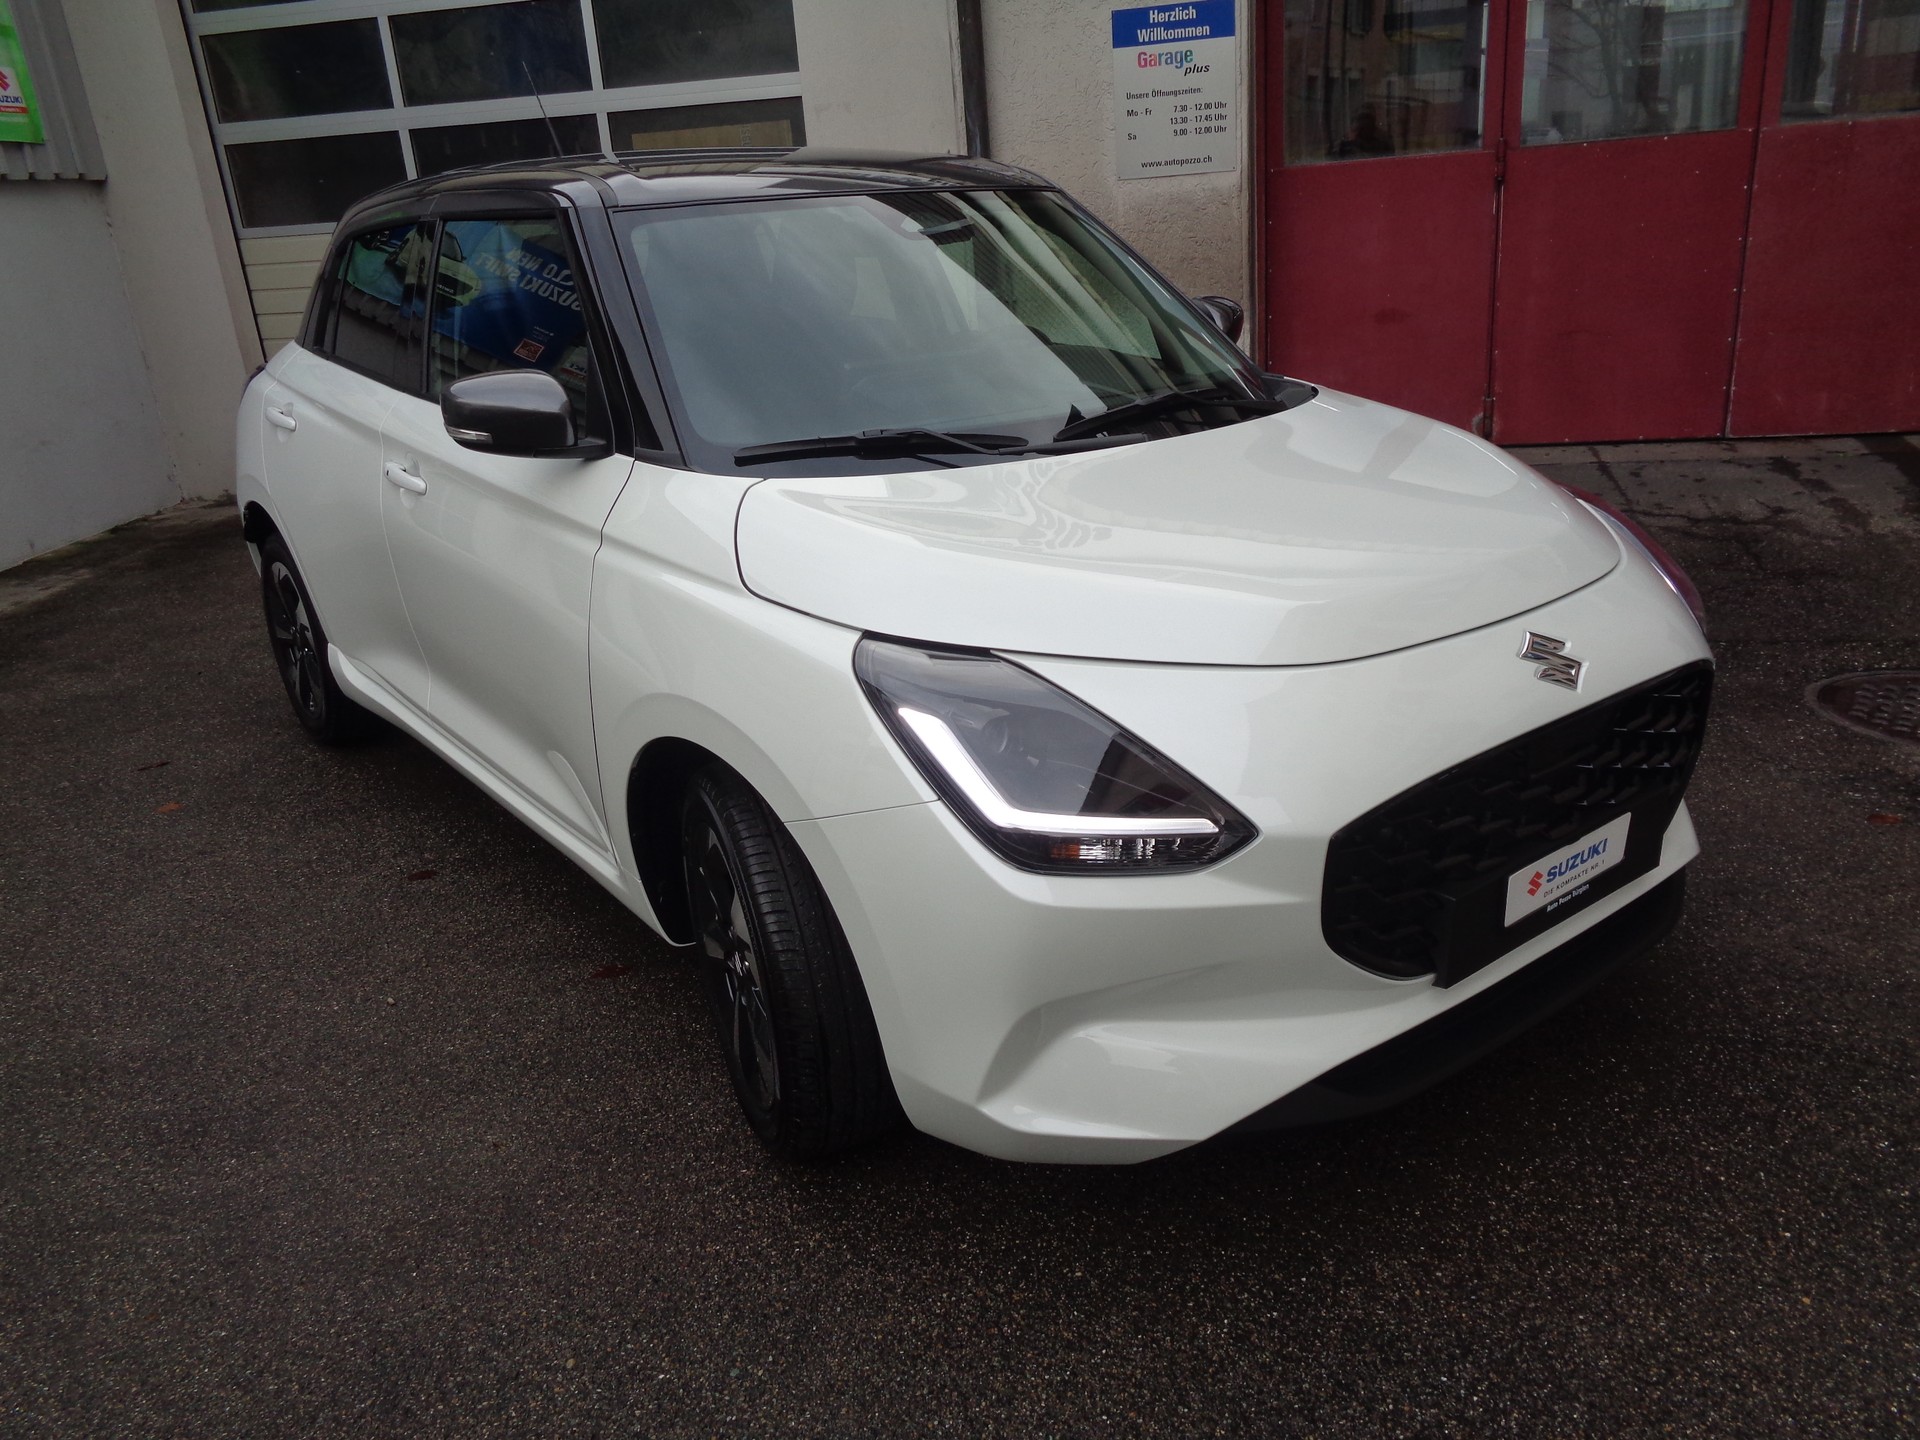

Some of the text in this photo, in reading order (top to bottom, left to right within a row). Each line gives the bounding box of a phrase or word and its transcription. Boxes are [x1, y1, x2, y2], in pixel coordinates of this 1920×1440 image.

[1149, 5, 1197, 24] Herzlich
[1137, 25, 1210, 43] Willkommen
[1137, 49, 1194, 69] Garage
[1184, 63, 1210, 77] plus
[0, 95, 24, 104] UZUKI
[1126, 86, 1203, 100] Unsere Öffnungszeiten:
[1126, 109, 1139, 117] Mo
[1145, 107, 1153, 116] Fr
[1173, 104, 1188, 113] 7.30
[1194, 102, 1212, 111] 12.00
[1214, 101, 1227, 110] Uhr
[1170, 116, 1188, 125] 13.30
[1195, 114, 1213, 123] 17.45
[1214, 113, 1227, 121] Uhr
[1127, 132, 1137, 141] Sa
[1173, 128, 1188, 137] 9.00
[1194, 126, 1212, 135] 12.00
[1214, 125, 1227, 133] Uhr
[1141, 155, 1212, 168] www.autopozzo.ch
[1546, 837, 1608, 884] SUZUKI
[1543, 887, 1554, 898] DIE
[1556, 867, 1589, 891] KOMPAKTE
